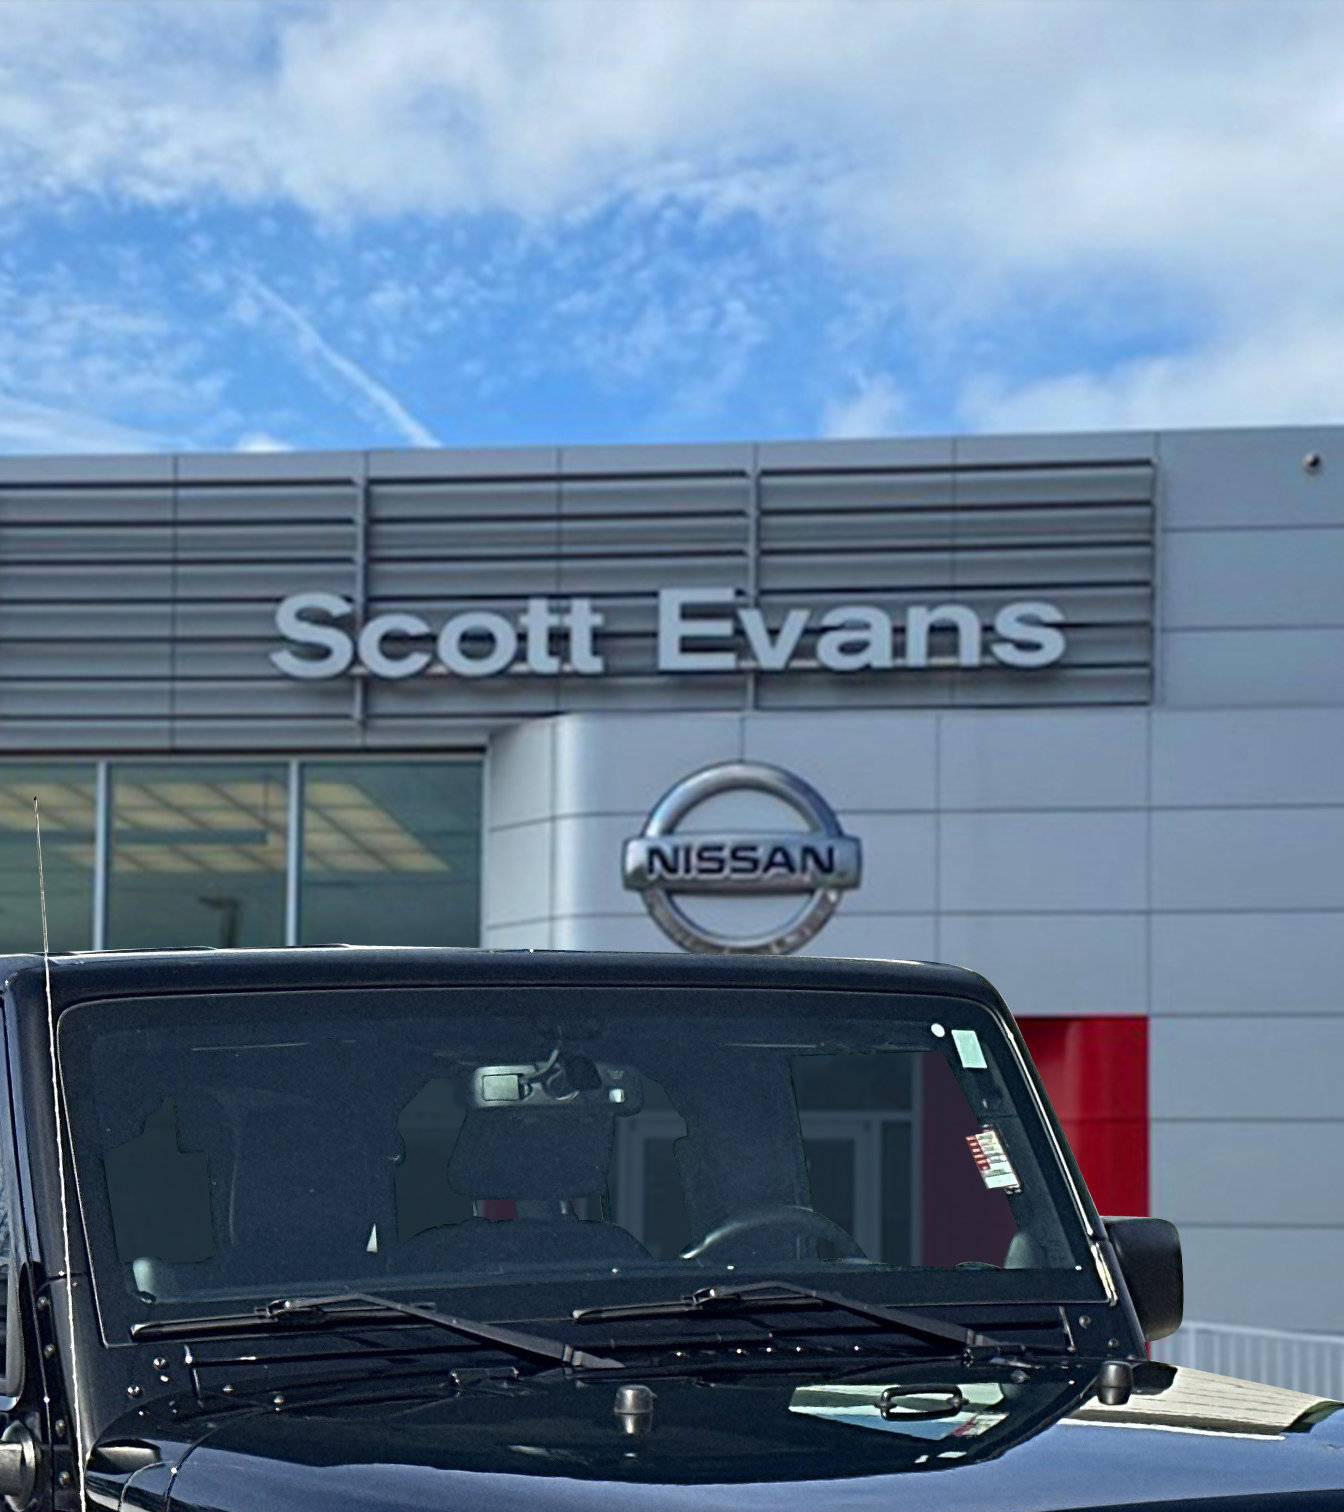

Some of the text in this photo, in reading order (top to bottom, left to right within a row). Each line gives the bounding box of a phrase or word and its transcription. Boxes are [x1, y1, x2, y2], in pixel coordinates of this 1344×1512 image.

[268, 586, 1067, 679] Scott Evans
[646, 844, 836, 879] NISSAN
